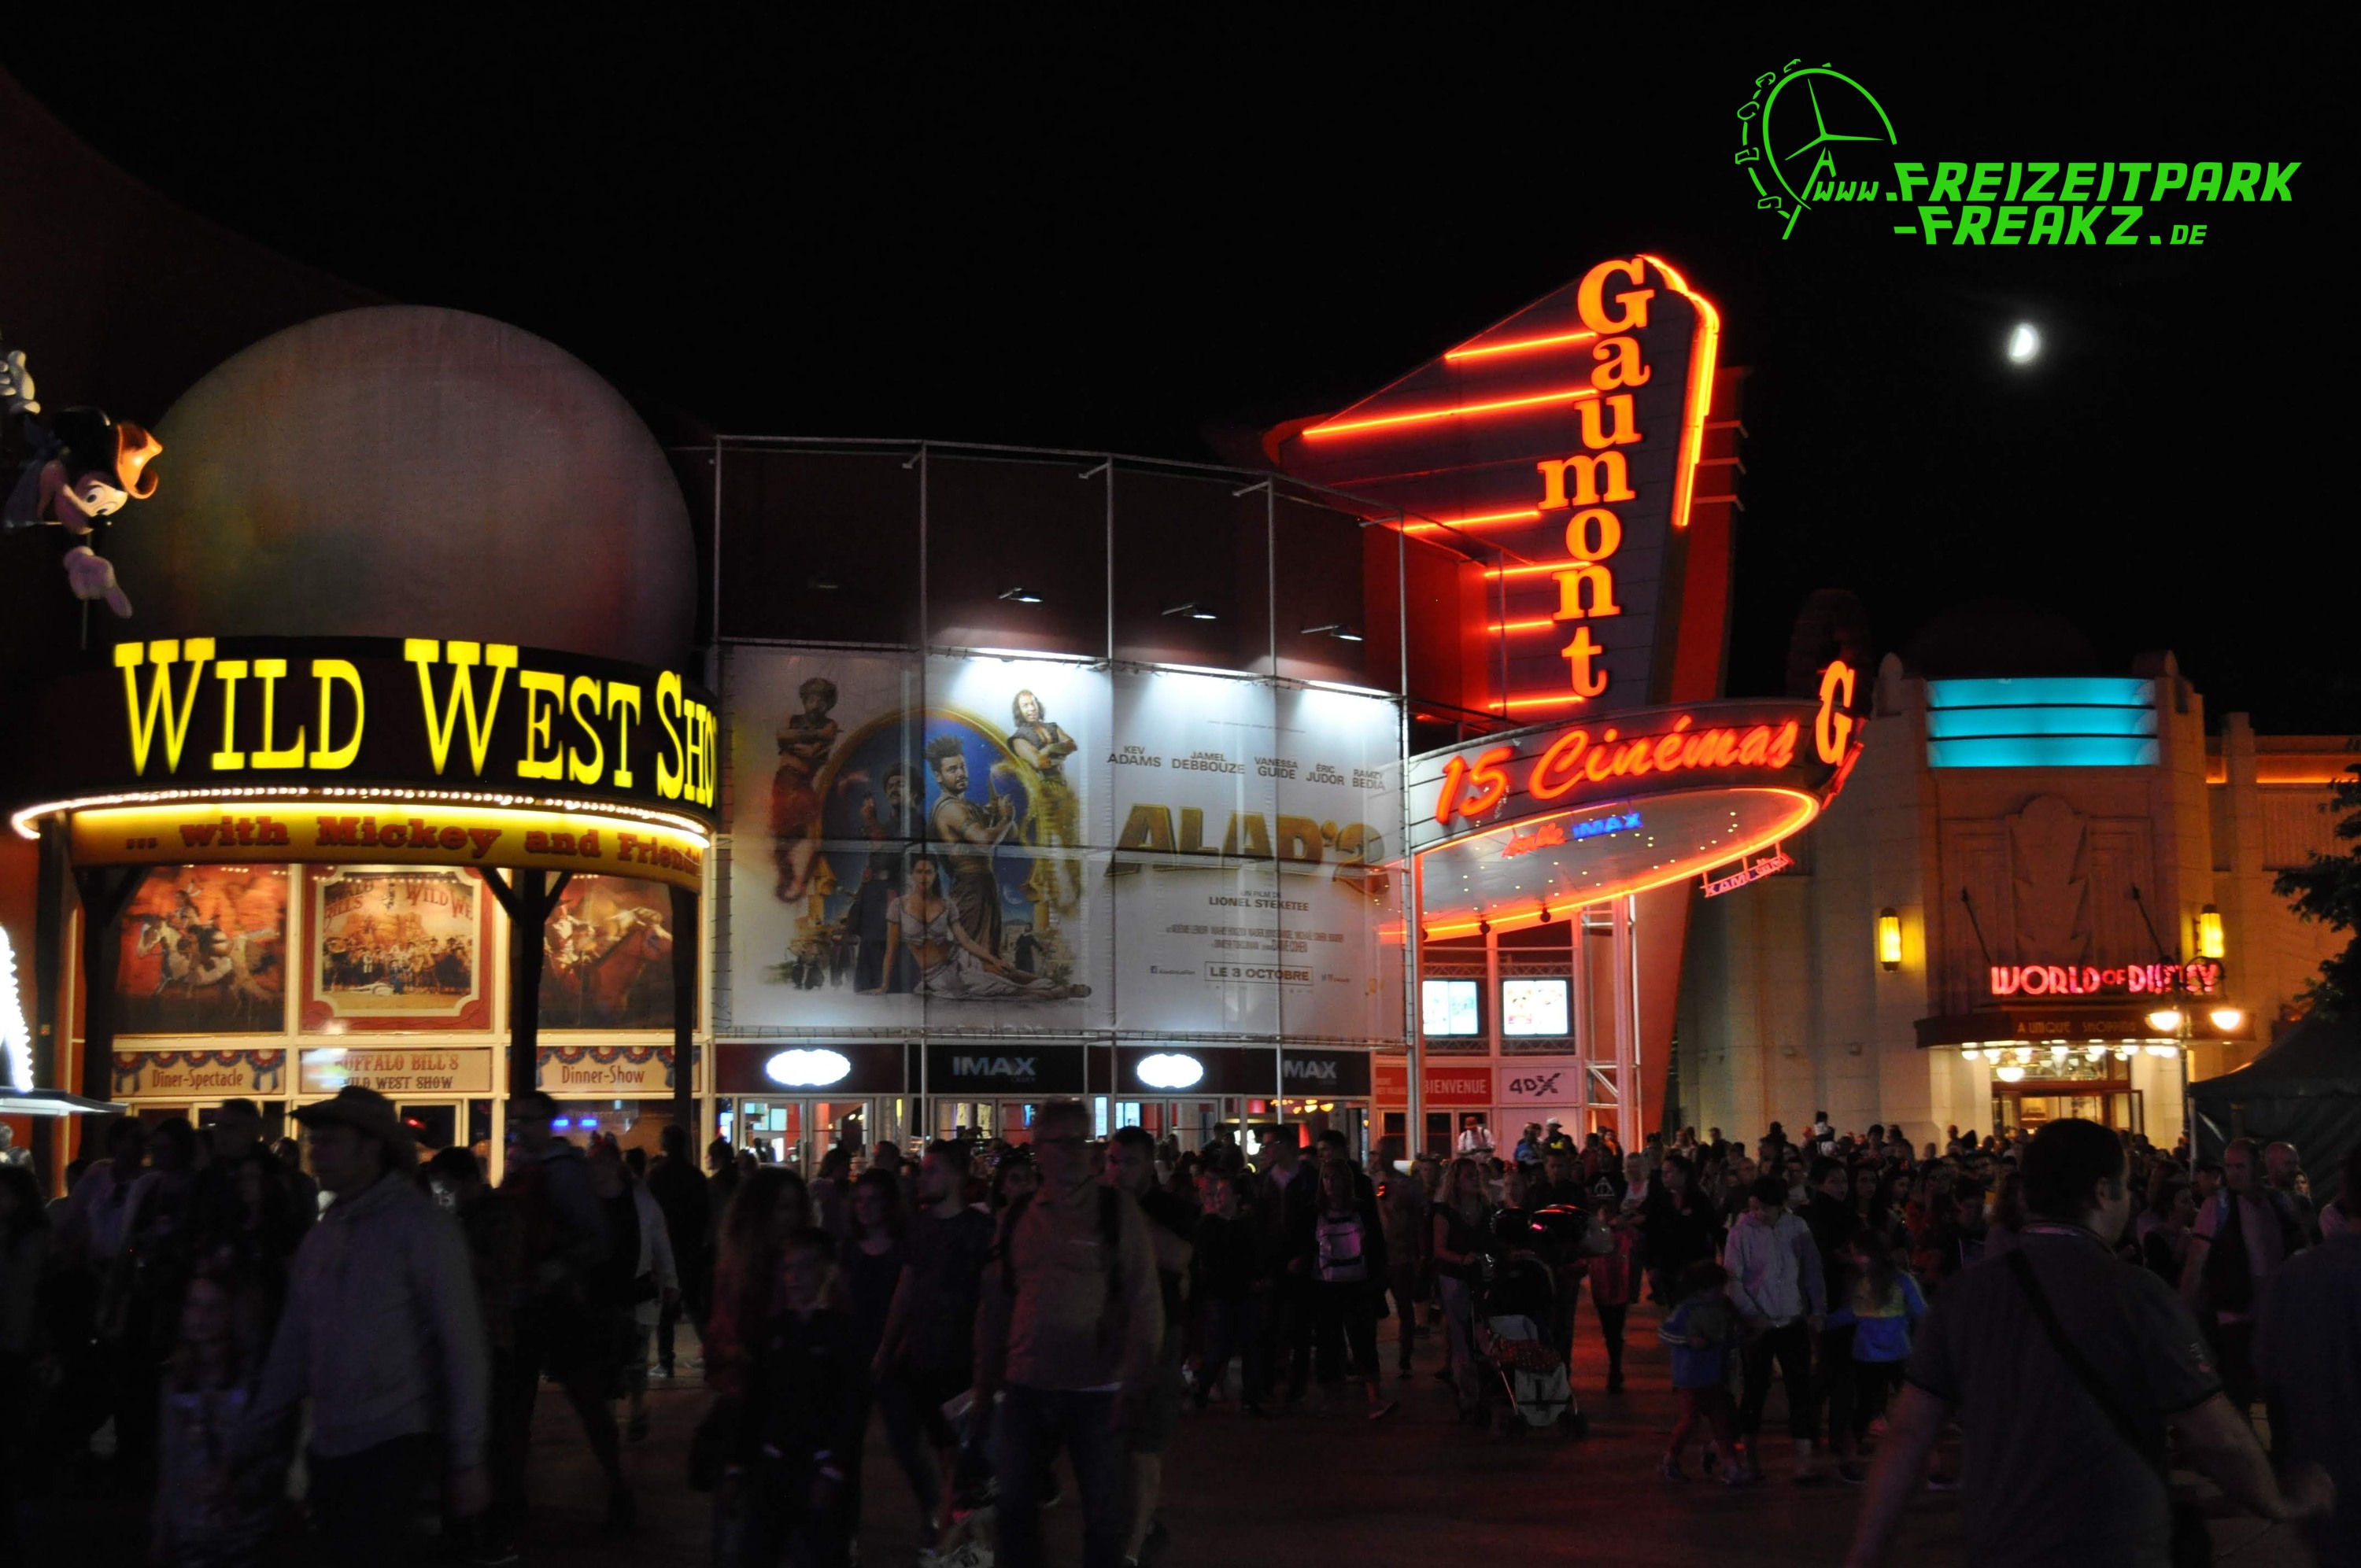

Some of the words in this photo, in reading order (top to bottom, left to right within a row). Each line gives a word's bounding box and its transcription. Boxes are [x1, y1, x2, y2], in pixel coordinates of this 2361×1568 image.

[1537, 256, 1656, 698] Gaumont
[114, 636, 364, 777] WILD
[404, 637, 641, 788] WEST
[656, 670, 718, 809] SHO
[1124, 745, 1145, 755] KEV
[1190, 751, 1226, 762] JAMEL
[1107, 753, 1162, 768] ADAMS
[1171, 758, 1246, 775] DEBBOUZE
[1254, 756, 1299, 769] VANESSA
[1258, 766, 1296, 780] GUIDE
[1435, 744, 1516, 825] 15
[1528, 714, 1800, 800] Cinémas
[1306, 772, 1345, 786] JUDOR
[1352, 778, 1386, 791] BEDIA
[1572, 811, 1643, 839] IMAX
[179, 815, 290, 847] with
[316, 815, 501, 858] Mickey
[524, 828, 602, 858] and
[1209, 895, 1251, 908] LIONEL
[1210, 966, 1229, 979] LE
[1232, 967, 1241, 979] 3
[1246, 968, 1310, 982] OCTOBRE
[1991, 965, 2101, 995] WORLD
[2102, 968, 2126, 986] OF
[341, 1054, 405, 1072] UFFALO
[410, 1053, 460, 1072] BILL'S
[951, 1057, 1038, 1076] IMAX
[1284, 1060, 1337, 1079] MAX
[376, 1075, 412, 1090] WEST
[416, 1075, 454, 1090] SHOW
[562, 1064, 646, 1084] Dinner-Show
[1424, 1079, 1487, 1094] BIENVENUE
[1509, 1072, 1562, 1097] 4DX
